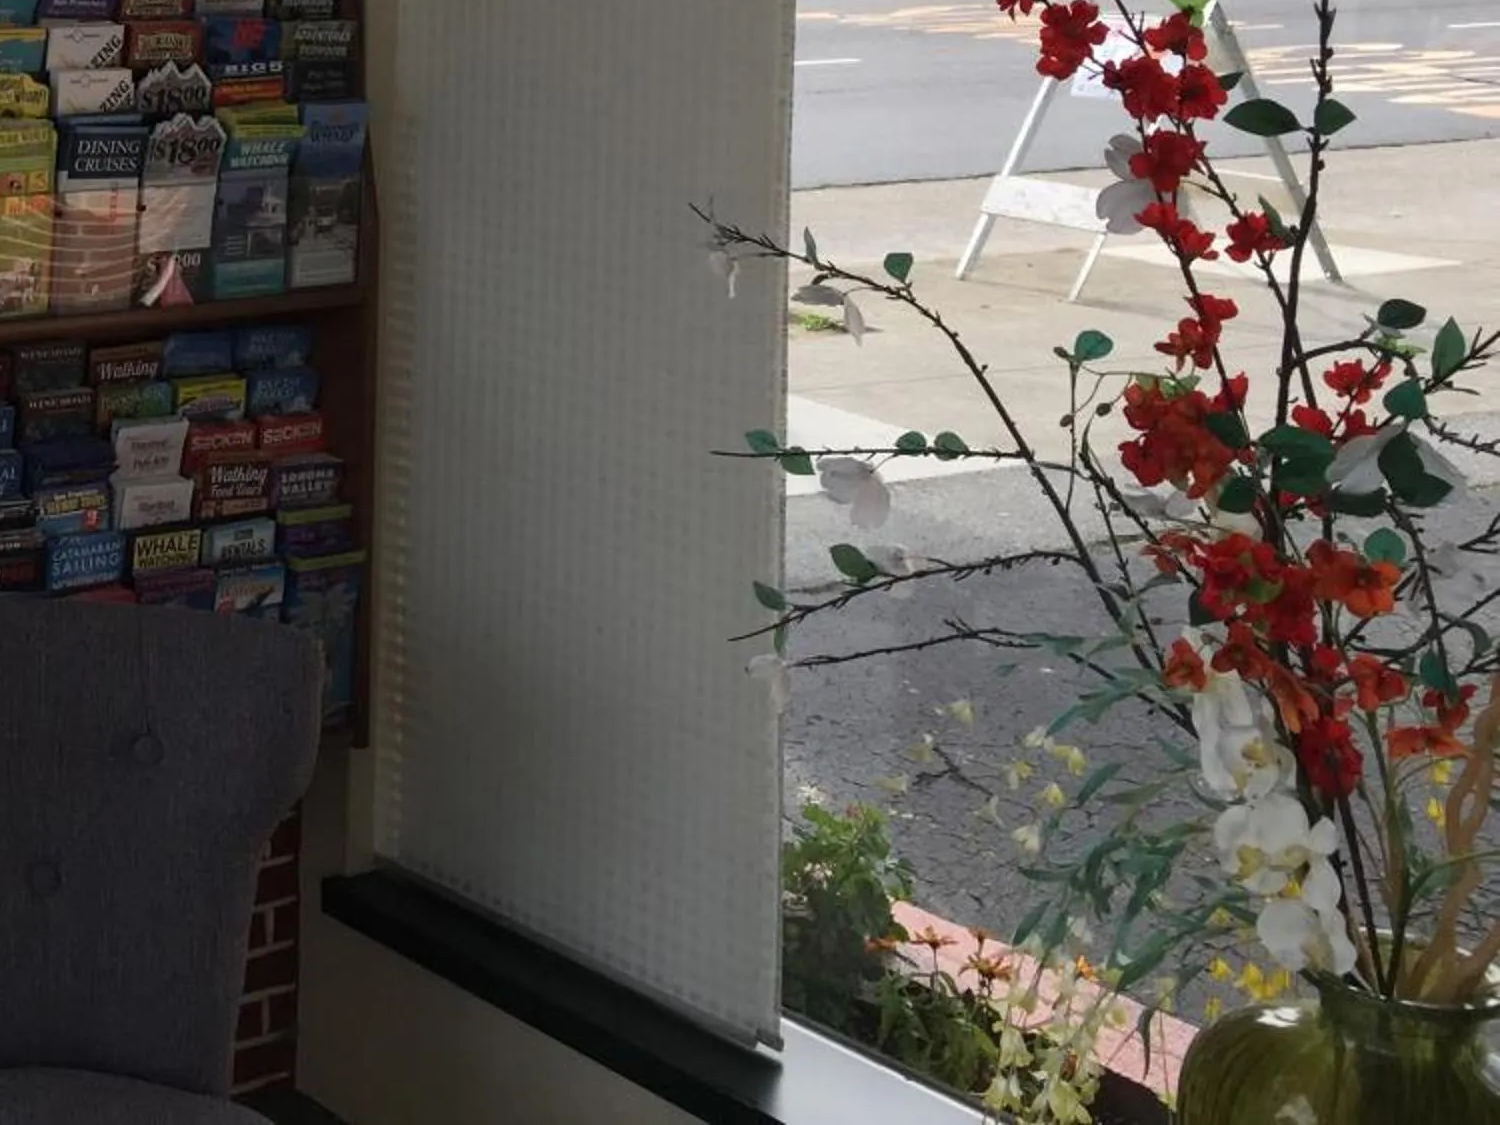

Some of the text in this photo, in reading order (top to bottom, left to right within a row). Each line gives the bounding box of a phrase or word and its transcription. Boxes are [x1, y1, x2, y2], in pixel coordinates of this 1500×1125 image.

[76, 139, 141, 155] DINING
[73, 157, 139, 173] CRUISES
[136, 533, 198, 557] WHALE
[52, 552, 120, 576] SAILING
